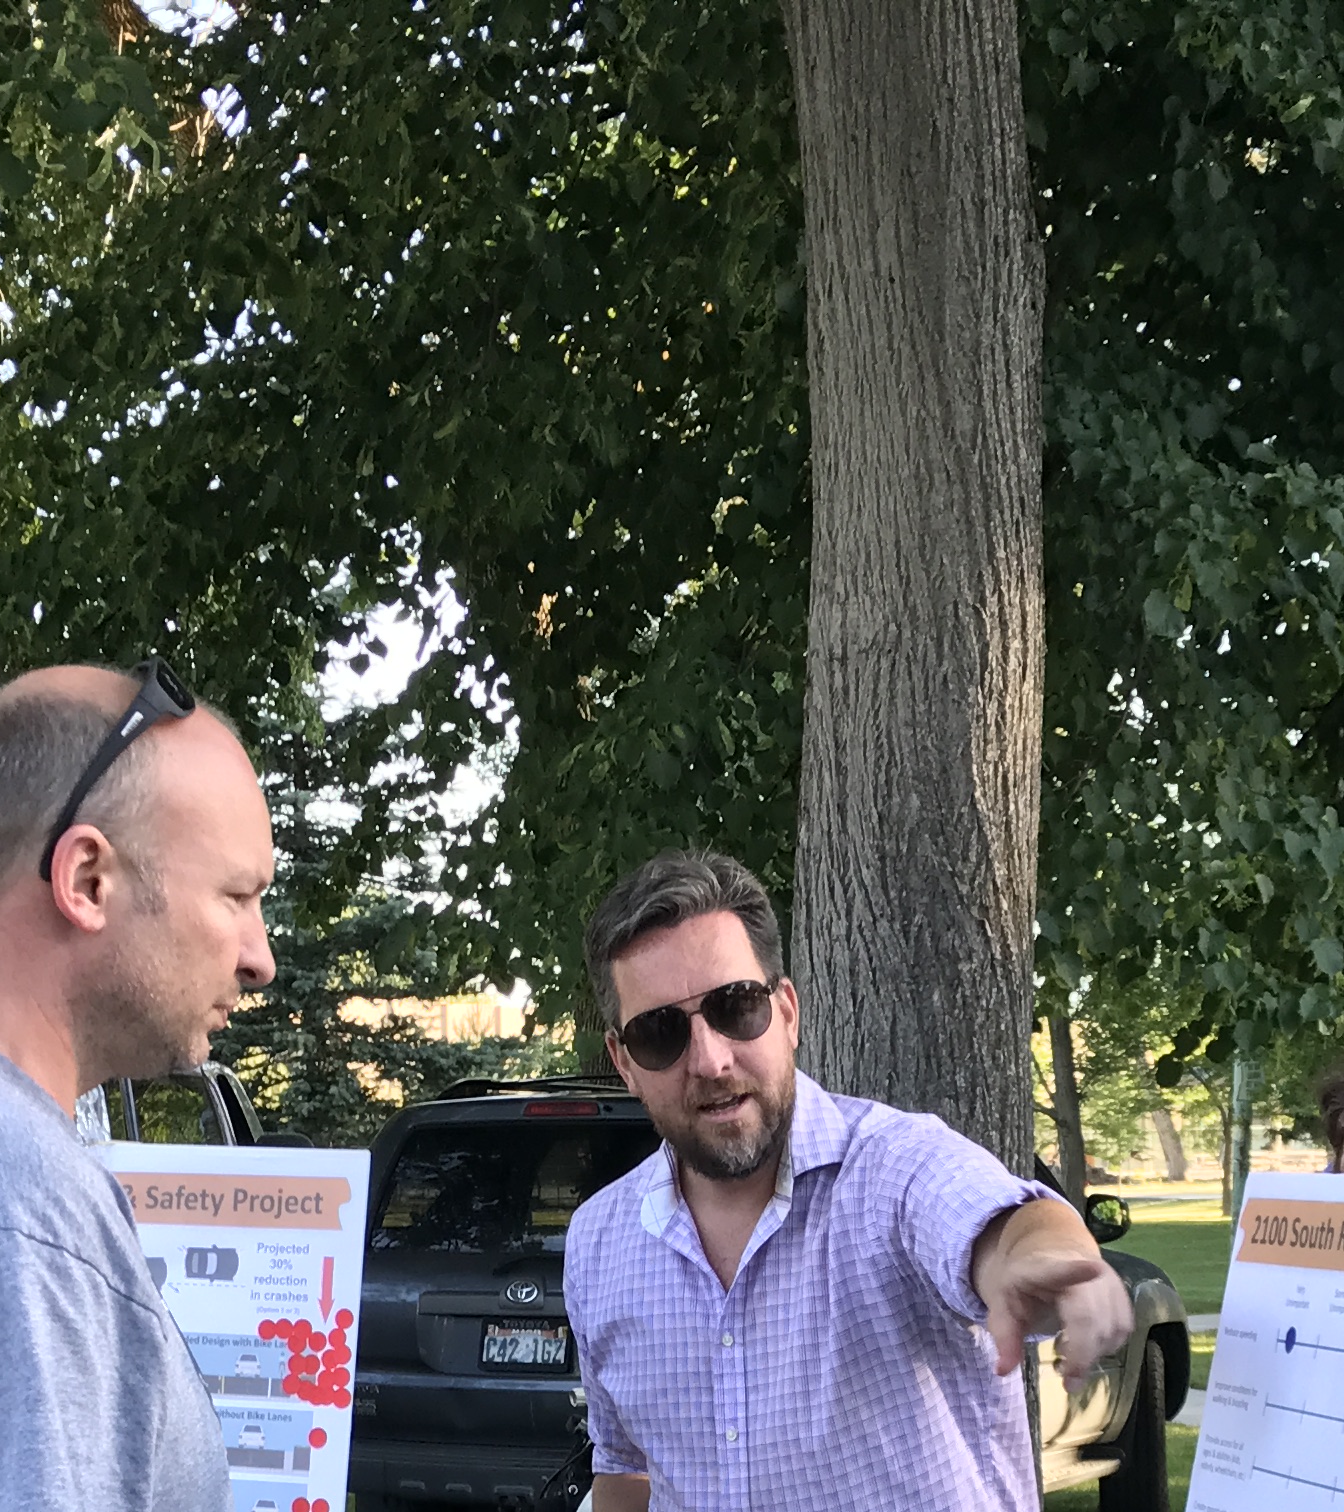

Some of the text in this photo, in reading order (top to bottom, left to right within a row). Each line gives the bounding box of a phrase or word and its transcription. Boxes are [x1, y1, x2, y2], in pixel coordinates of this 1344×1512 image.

[145, 1185, 225, 1217] Safety
[233, 1187, 324, 1219] Project
[1250, 1214, 1287, 1248] 2100
[1290, 1217, 1334, 1253] South
[257, 1242, 309, 1256] Projected
[269, 1259, 293, 1270] 30%
[254, 1275, 308, 1286] reduction
[250, 1289, 309, 1302] in crashes
[502, 1319, 551, 1329] TOYOTA
[201, 1336, 230, 1348] Design
[232, 1337, 252, 1347] with
[247, 1410, 266, 1421] Bike
[267, 1412, 293, 1423] Lanes
